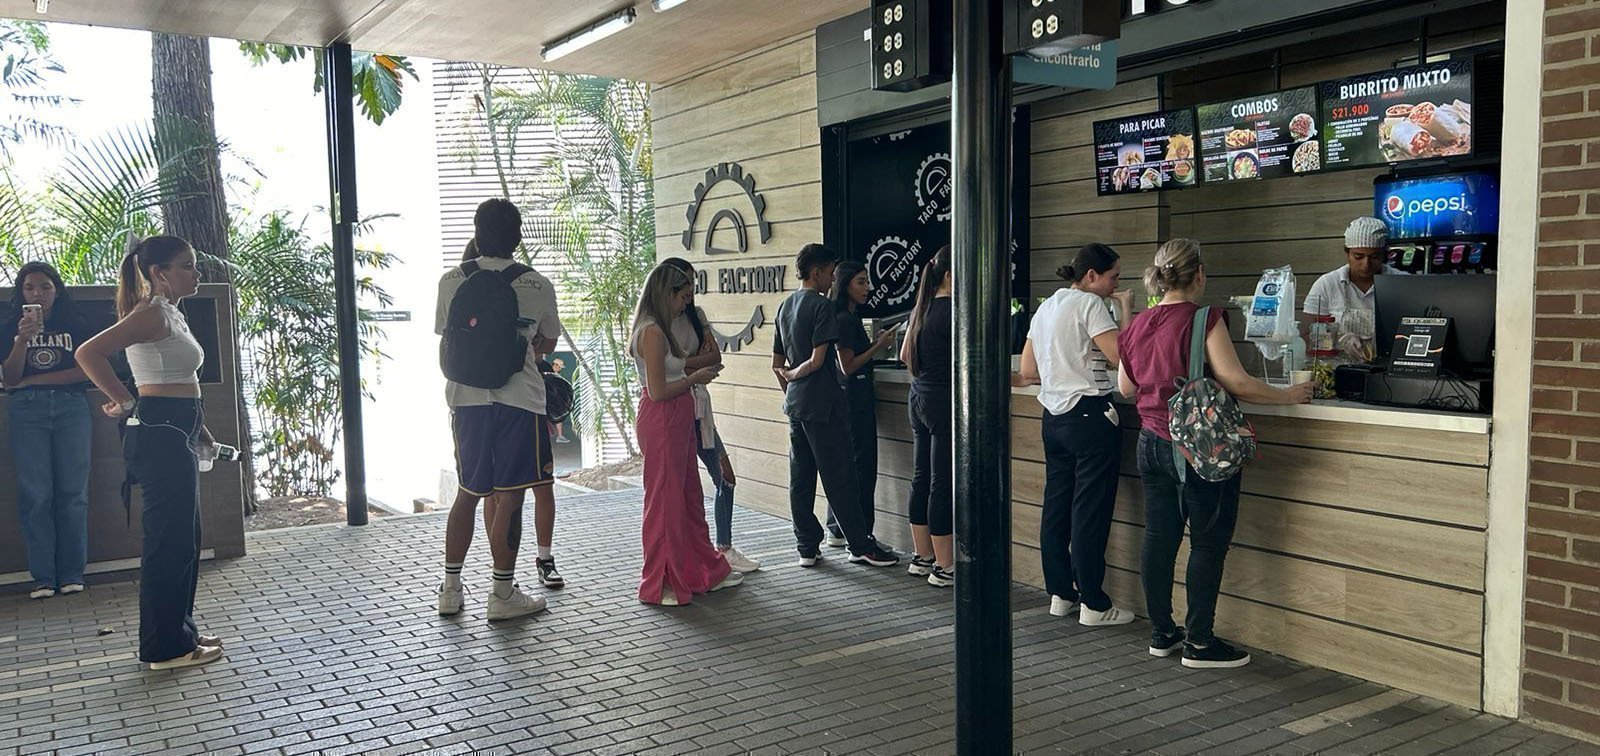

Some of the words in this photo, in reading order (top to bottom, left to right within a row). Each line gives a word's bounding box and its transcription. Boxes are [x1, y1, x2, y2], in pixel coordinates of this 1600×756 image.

[1340, 77, 1398, 100] BURRITO
[1403, 68, 1450, 90] MIXTO
[1231, 98, 1278, 118] COMBOS
[1332, 104, 1369, 119] $21.900
[1119, 121, 1140, 134] PARA
[1141, 117, 1166, 131] PICAR
[917, 200, 938, 225] TACO
[1408, 193, 1465, 217] pepsi
[718, 265, 786, 293] FACTORY
[867, 284, 889, 309] TACO
[889, 239, 923, 282] FACTORY
[27, 332, 73, 352] KLAND
